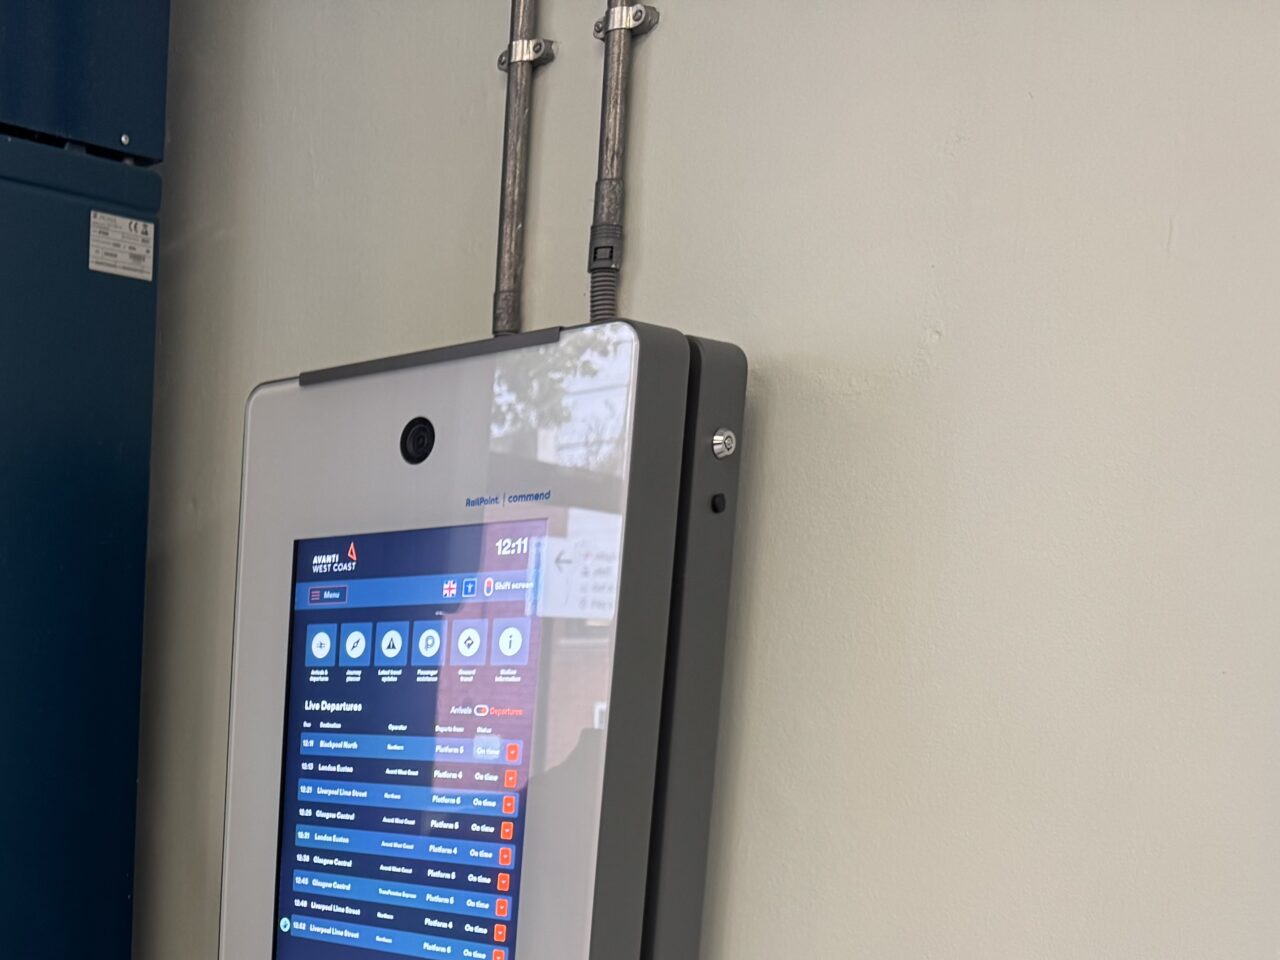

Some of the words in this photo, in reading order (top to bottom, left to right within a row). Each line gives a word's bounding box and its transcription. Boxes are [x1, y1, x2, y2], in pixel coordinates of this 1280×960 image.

[508, 490, 551, 503] commend
[495, 537, 529, 556] 12:11
[312, 553, 339, 564] AVANTI
[312, 564, 331, 573] WEST
[333, 562, 356, 572] COAST
[495, 580, 510, 590] Shift
[511, 581, 534, 590] screen
[324, 590, 340, 599] Menu
[304, 700, 320, 711] Live
[321, 700, 362, 713] Departures
[450, 705, 472, 715] Arrivals
[490, 706, 523, 717] Departures
[388, 723, 407, 731] Operator
[319, 740, 343, 749] Blackpool
[343, 741, 358, 749] North
[435, 745, 459, 754] Platform
[476, 747, 485, 755] On
[318, 763, 336, 772] London
[337, 764, 353, 773] Euston
[434, 769, 457, 779] Platform
[475, 772, 484, 780] On
[484, 773, 498, 781] time
[317, 787, 339, 796] Liverpool
[340, 788, 351, 796] Lime
[352, 789, 367, 797] Street
[432, 795, 456, 804] Platform
[473, 798, 482, 806] On
[482, 799, 496, 807] time
[315, 809, 336, 819] Glasgow
[336, 811, 355, 821] Central
[430, 819, 454, 829] Platform
[471, 823, 480, 832] On
[481, 824, 495, 833] time
[314, 832, 332, 842] London
[333, 834, 349, 844] Euston
[429, 844, 452, 854] Platform
[469, 848, 479, 857] On
[479, 850, 493, 858] time
[313, 855, 333, 866] Glasgow
[334, 858, 352, 867] Central
[427, 868, 451, 878] Platform
[468, 873, 477, 882] On
[477, 875, 491, 884] time
[312, 878, 332, 888] Glasgow
[333, 880, 351, 890] Central
[426, 893, 449, 903] Platform
[466, 898, 475, 907] On
[476, 900, 490, 909] time
[311, 901, 333, 912] Liverpool
[333, 904, 345, 913] Lime
[345, 906, 360, 915] Street
[424, 918, 448, 928] Platform
[465, 924, 474, 932] On
[474, 926, 488, 934] time
[310, 924, 332, 935] Liverpool
[332, 926, 344, 936] Lime
[344, 929, 359, 938] Street
[423, 942, 446, 953] Platform
[463, 949, 472, 957] On
[473, 950, 486, 959] time
